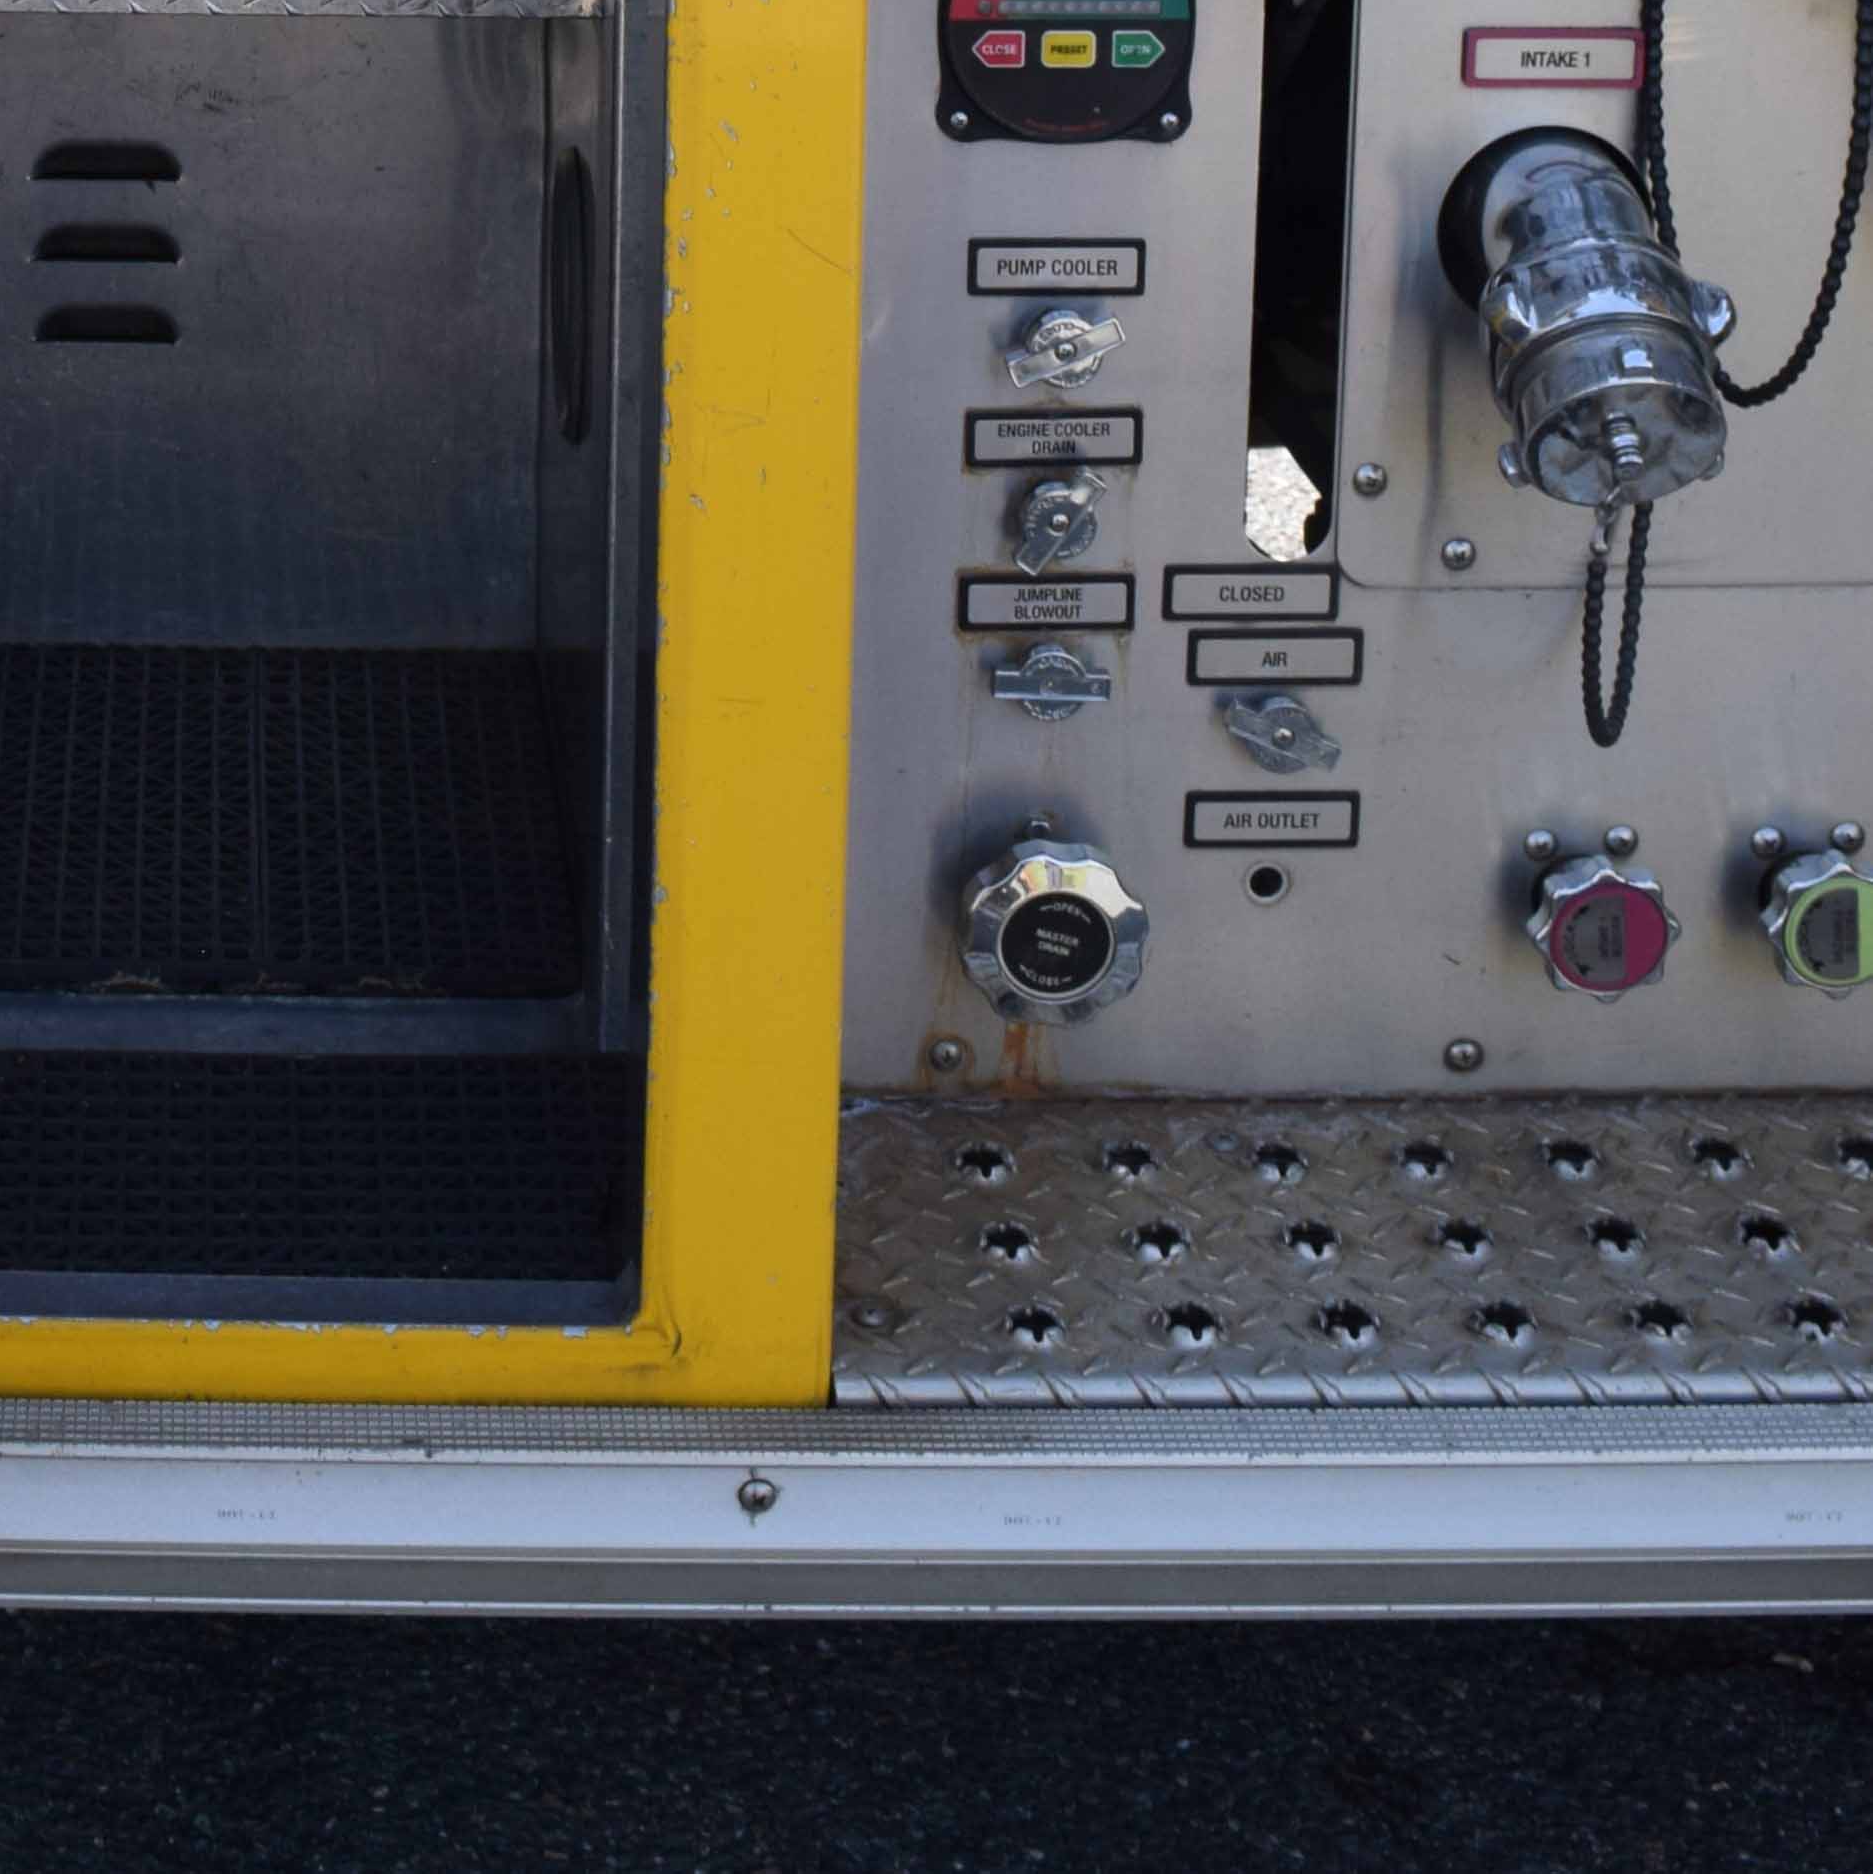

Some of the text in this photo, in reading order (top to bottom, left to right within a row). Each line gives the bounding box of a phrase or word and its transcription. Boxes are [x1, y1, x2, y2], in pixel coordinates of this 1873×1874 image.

[982, 44, 1016, 54] CLOSE
[1050, 45, 1088, 54] PRESET
[1120, 44, 1152, 54] OPEN
[1521, 52, 1590, 67] INTAKE 1
[997, 260, 1118, 276] PUMP COOLER
[998, 423, 1110, 438] ENGINE COOLER
[1032, 440, 1076, 454] DRAIN
[1013, 587, 1083, 602] JUMPLINE
[1218, 586, 1285, 602] CLOSED
[1014, 605, 1082, 619] BLOWOUT
[1261, 652, 1288, 668] AIR
[1224, 813, 1322, 829] AIR OUTLET
[1036, 928, 1079, 947] MASTER
